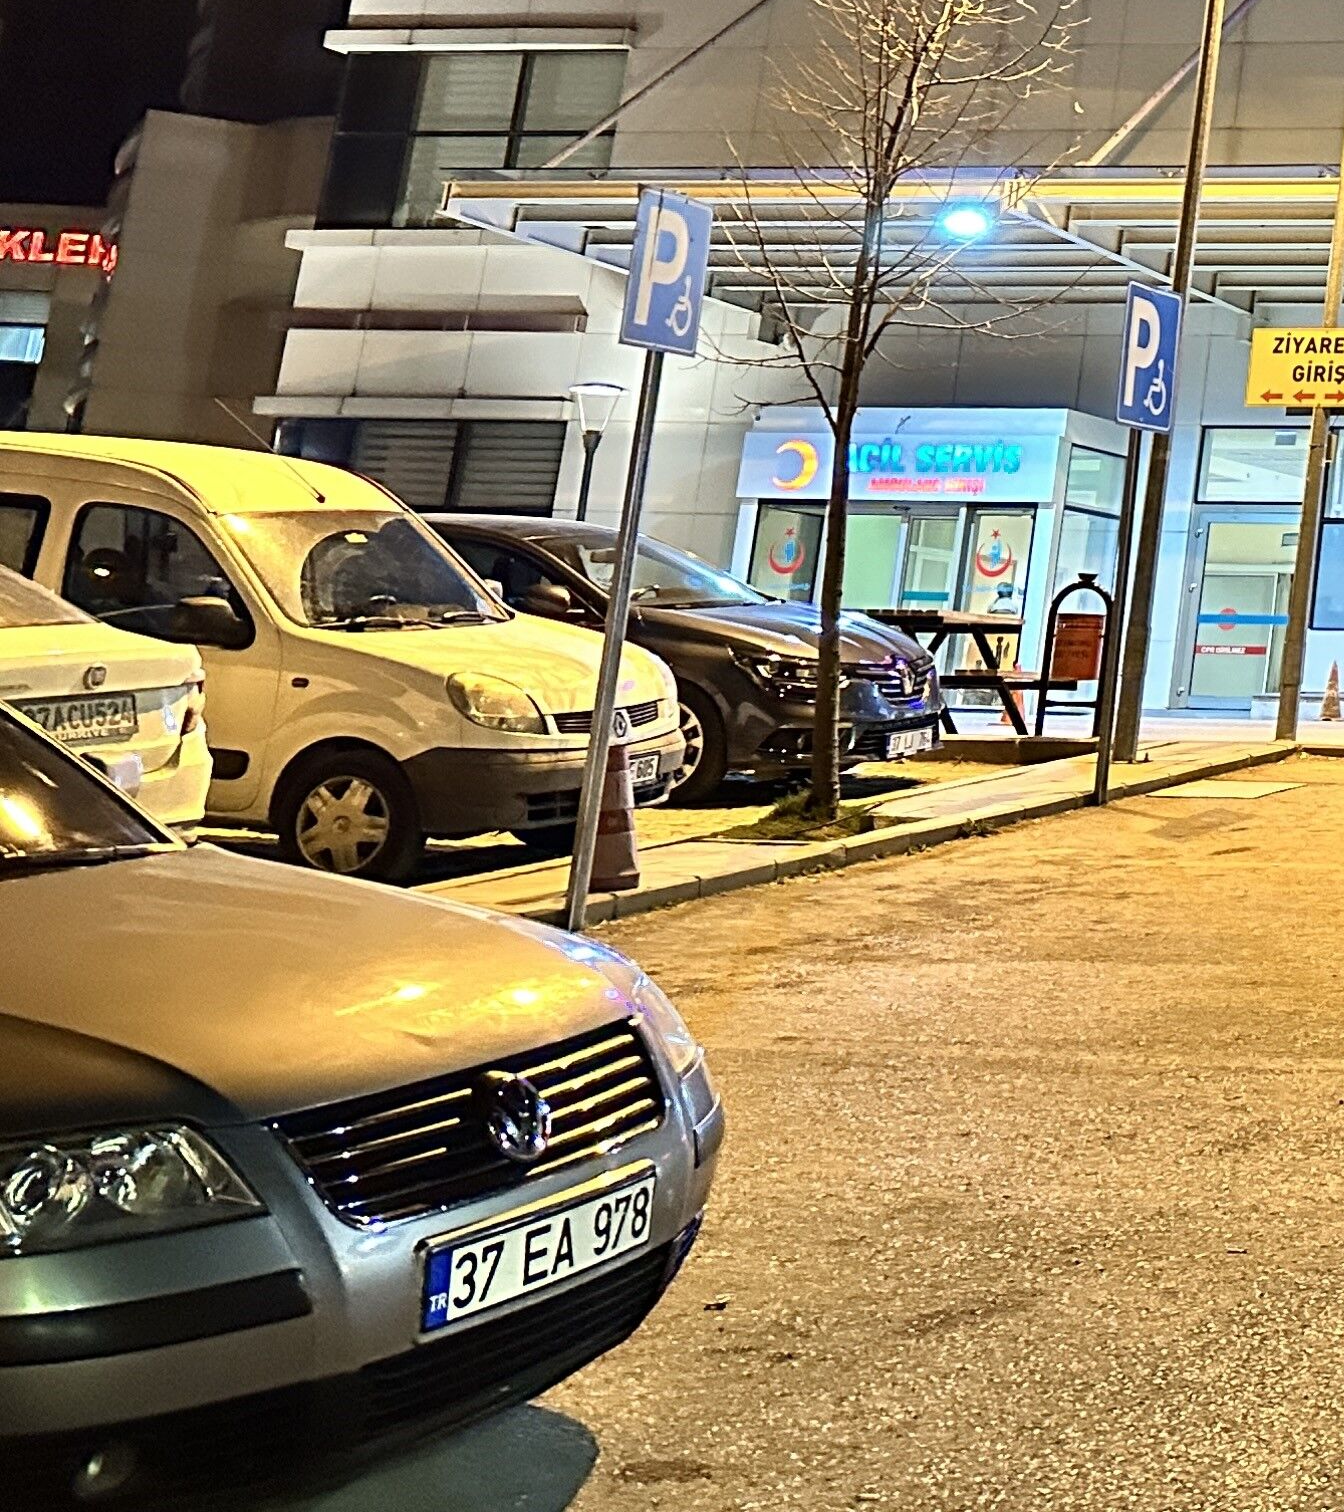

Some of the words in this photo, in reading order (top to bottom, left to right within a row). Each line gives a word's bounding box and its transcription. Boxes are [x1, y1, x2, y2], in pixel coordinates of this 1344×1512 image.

[634, 206, 690, 325] P
[1124, 295, 1161, 407] P
[915, 439, 1022, 474] SERVİS
[453, 1239, 505, 1309] 37
[523, 1217, 574, 1287] EA
[593, 1187, 649, 1256] 978
